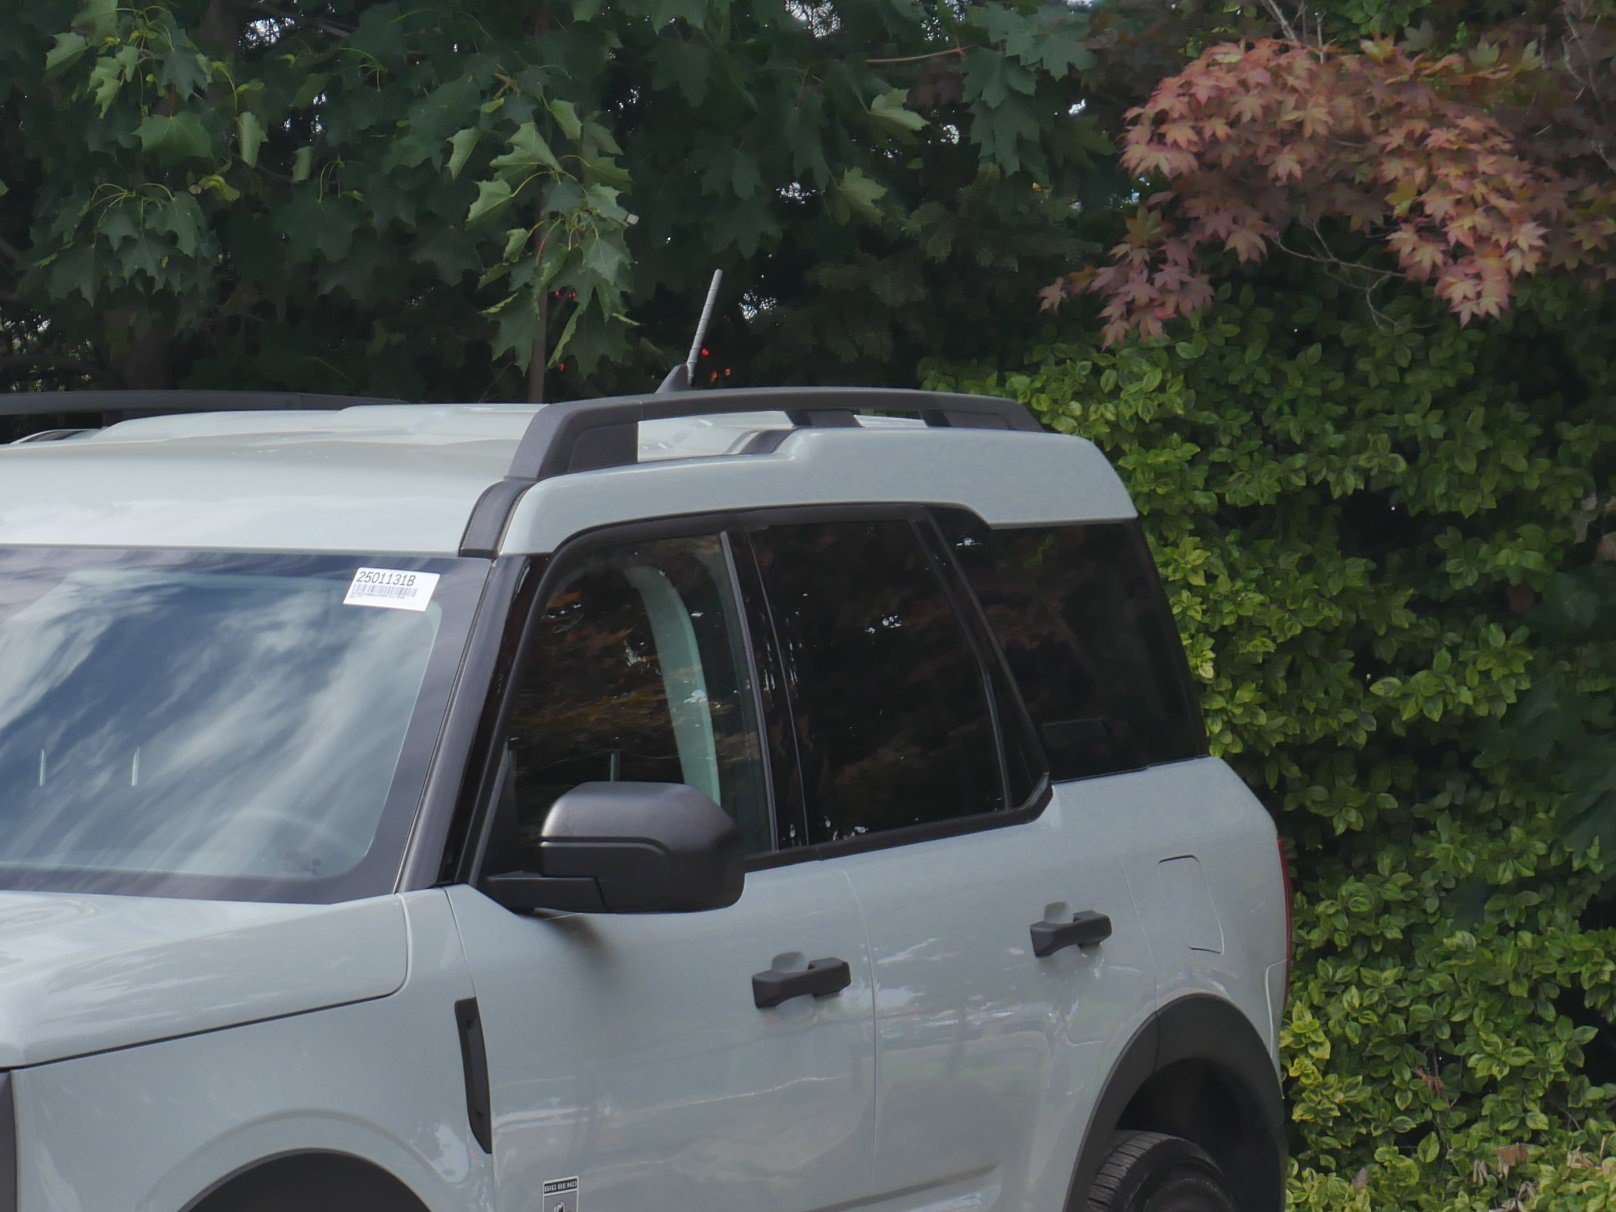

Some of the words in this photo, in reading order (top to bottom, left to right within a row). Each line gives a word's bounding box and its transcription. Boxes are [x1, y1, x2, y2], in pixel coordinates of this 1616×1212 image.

[356, 571, 417, 587] 2501131B
[544, 1184, 557, 1192] BIG
[557, 1181, 577, 1190] BEND
